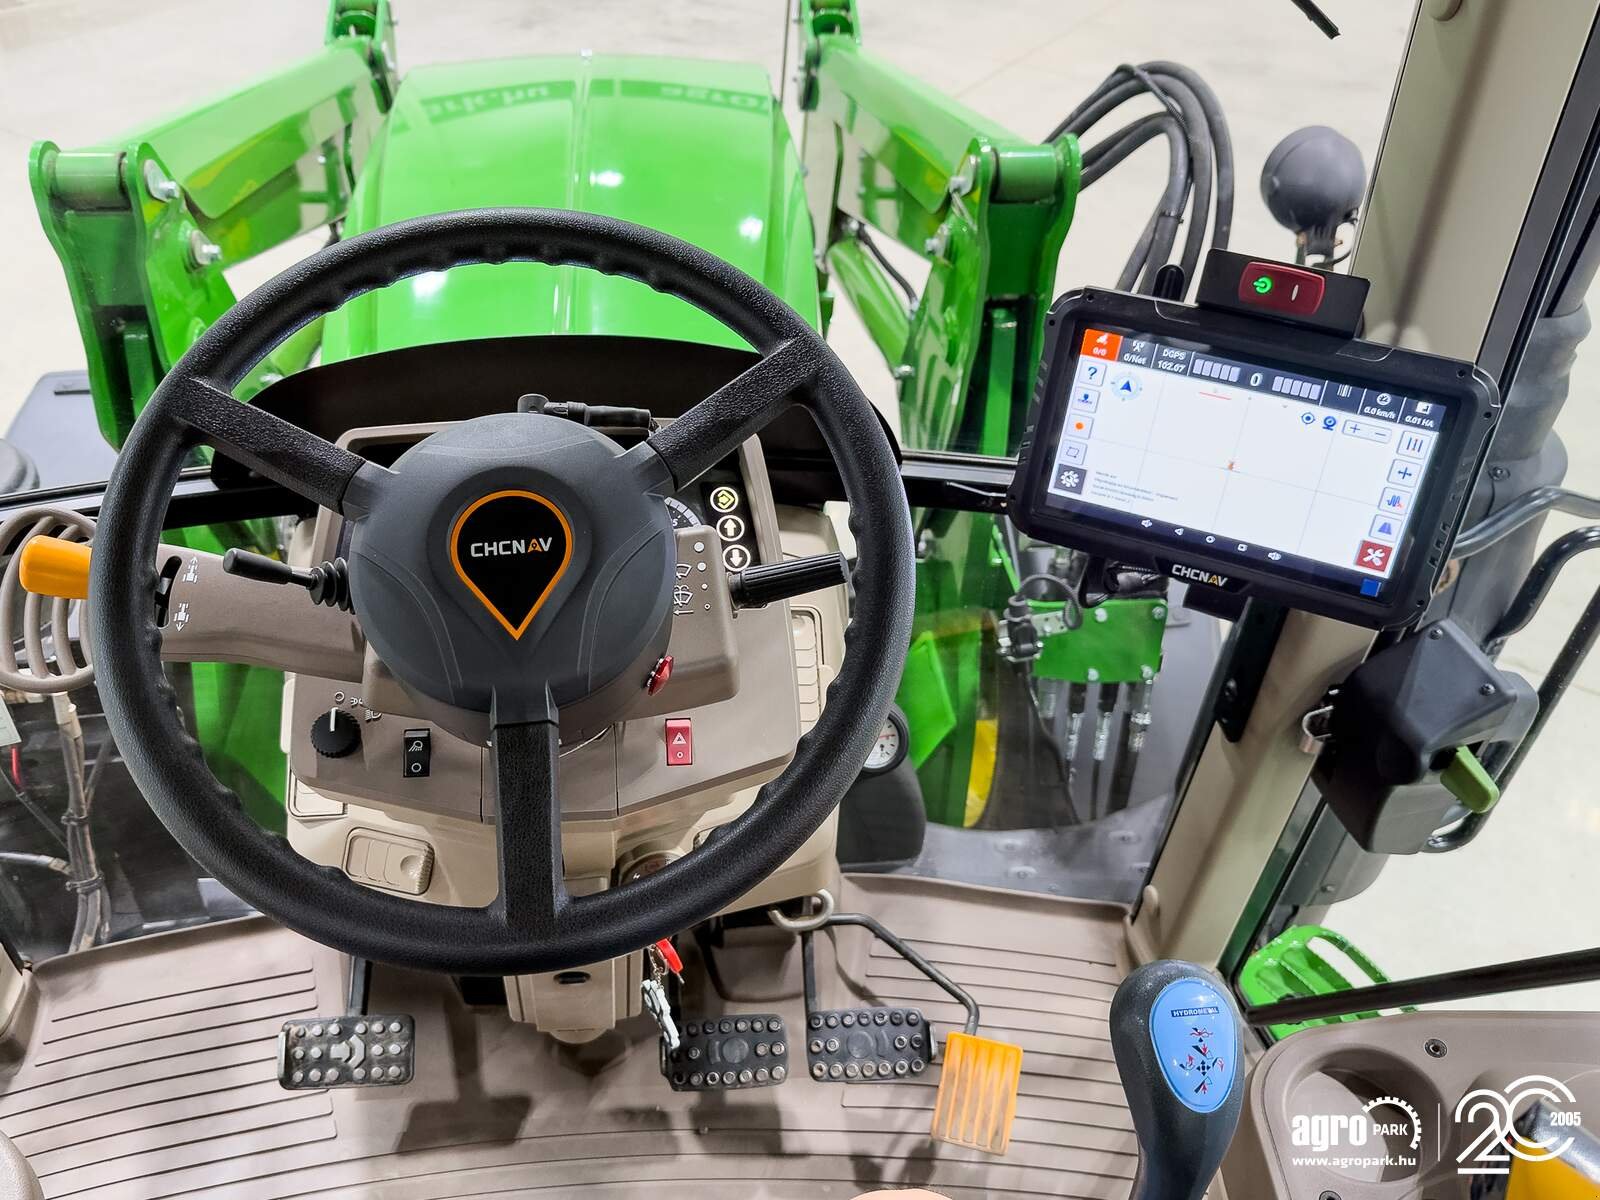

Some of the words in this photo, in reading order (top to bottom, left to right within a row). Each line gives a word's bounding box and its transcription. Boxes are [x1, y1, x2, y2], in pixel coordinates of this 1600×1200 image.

[1162, 348, 1187, 360] DGPS
[1250, 372, 1263, 387] 0
[470, 537, 553, 558] CHCNAV
[1171, 563, 1228, 587] CHCNAV
